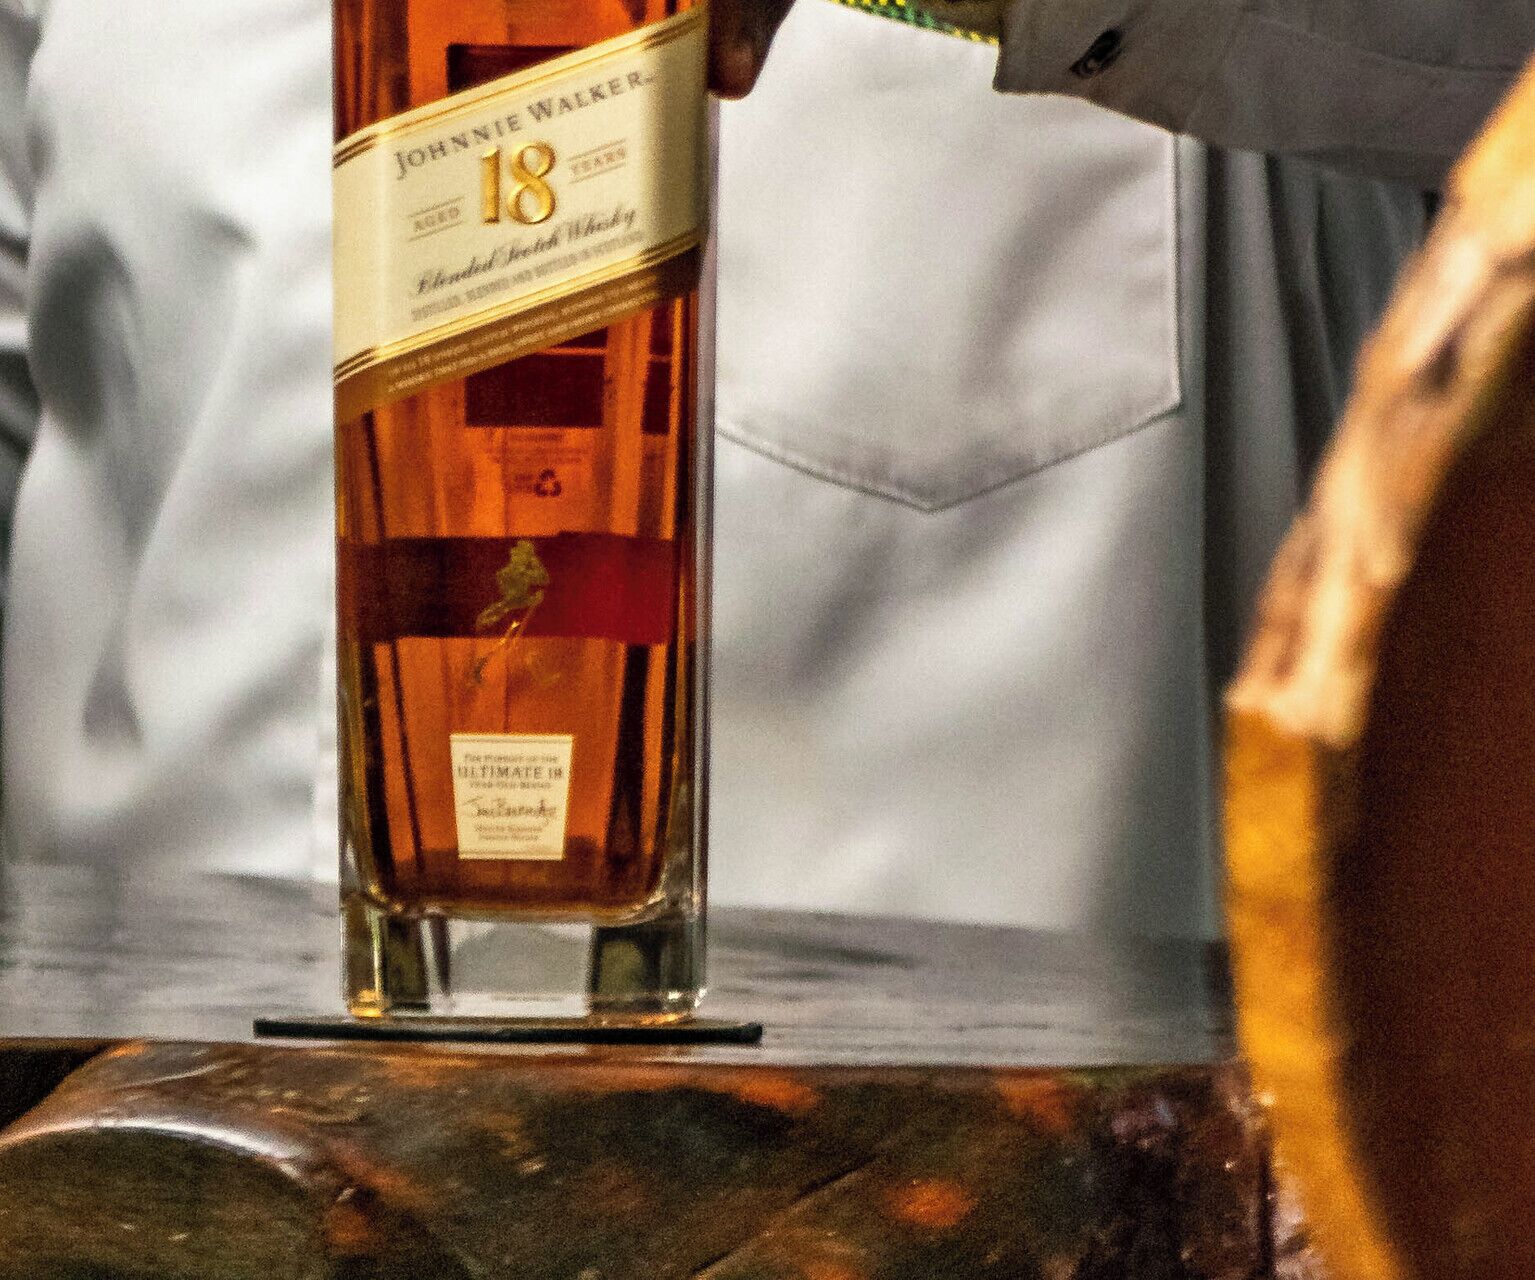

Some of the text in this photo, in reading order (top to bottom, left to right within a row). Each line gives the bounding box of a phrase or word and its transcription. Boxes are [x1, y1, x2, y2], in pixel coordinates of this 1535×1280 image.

[393, 113, 524, 181] JOHNNIE
[479, 139, 558, 227] 18
[458, 765, 542, 779] ULTIMATE
